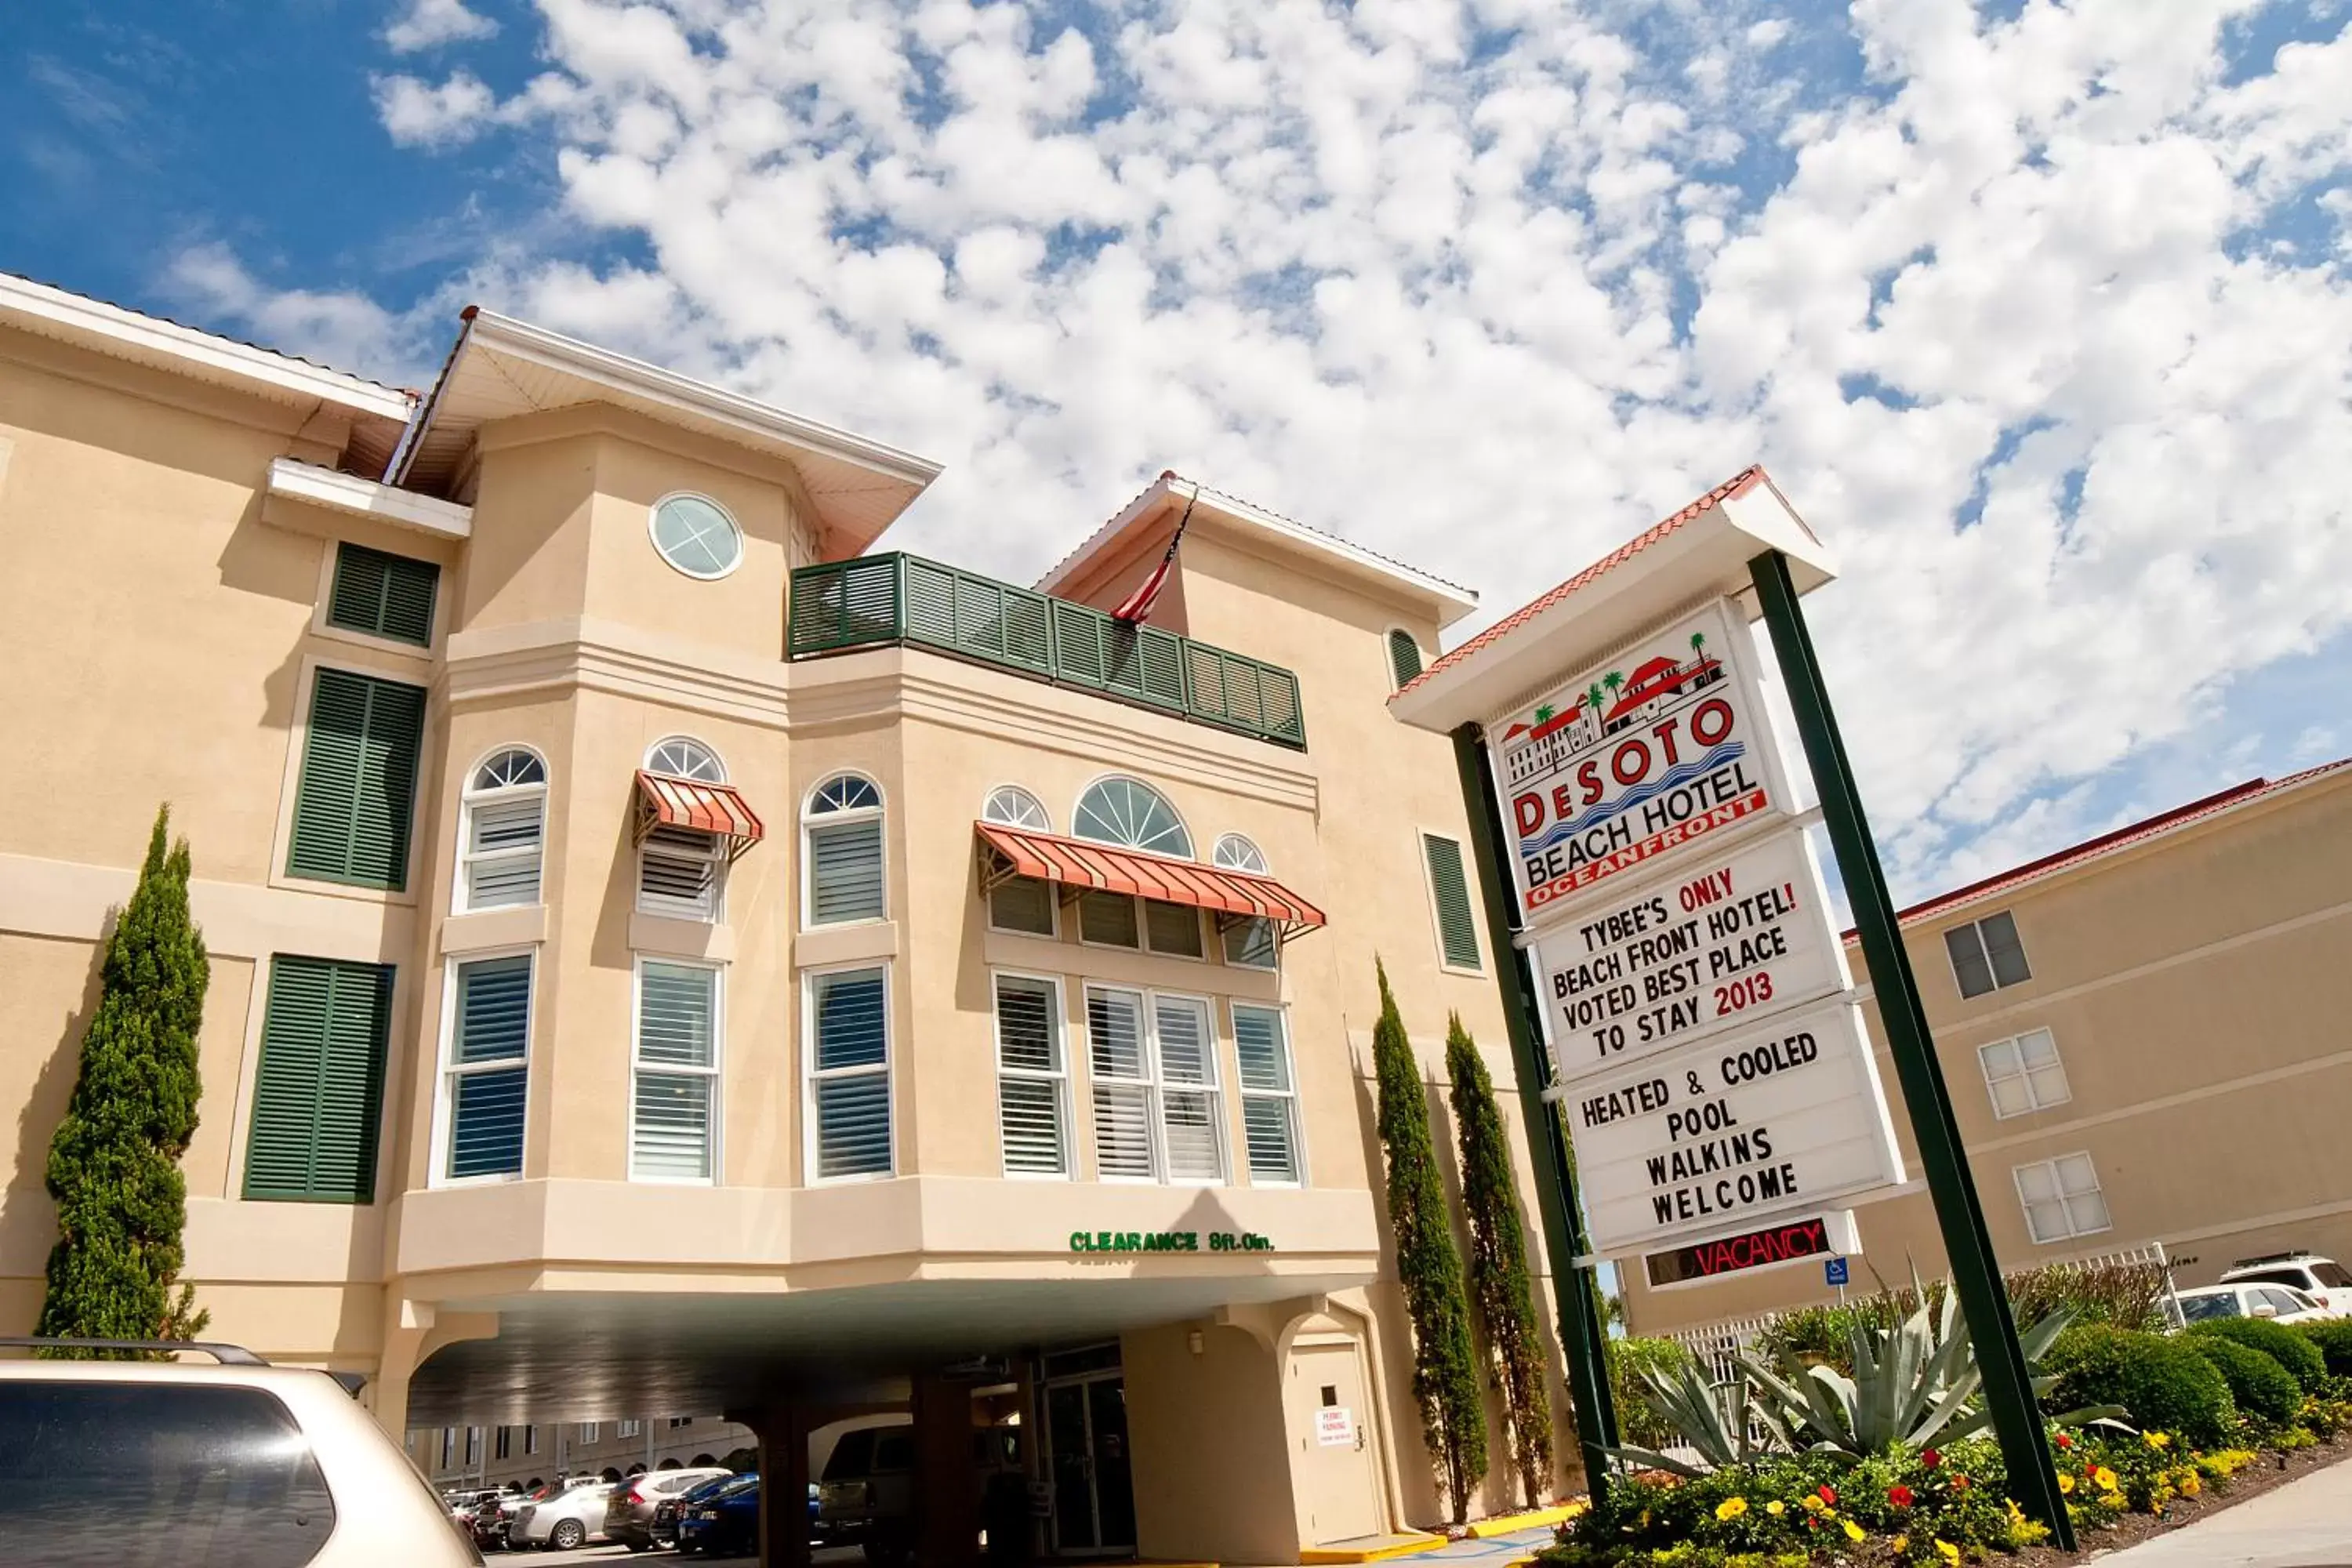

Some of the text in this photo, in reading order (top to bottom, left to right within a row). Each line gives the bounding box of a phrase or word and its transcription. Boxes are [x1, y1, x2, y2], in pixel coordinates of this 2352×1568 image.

[1526, 762, 1757, 887] BEACH HOTEL
[1532, 793, 1761, 905] OCEANFRONT
[1553, 883, 1797, 1000] BEACH FRONT HOTEL!
[1581, 868, 1733, 952] TYBEE'S ONLY
[1563, 927, 1787, 1030] VOTED BEST PLACE
[1593, 971, 1773, 1057] TO STAY 2013
[1581, 1033, 1817, 1127] HEATED & COOLED
[1667, 1098, 1737, 1142] POOL
[1646, 1127, 1772, 1186] WALKINS
[1653, 1163, 1797, 1224] WELCOME
[1069, 1232, 1199, 1251] CLEARANCE
[1696, 1222, 1820, 1276] VACANCY
